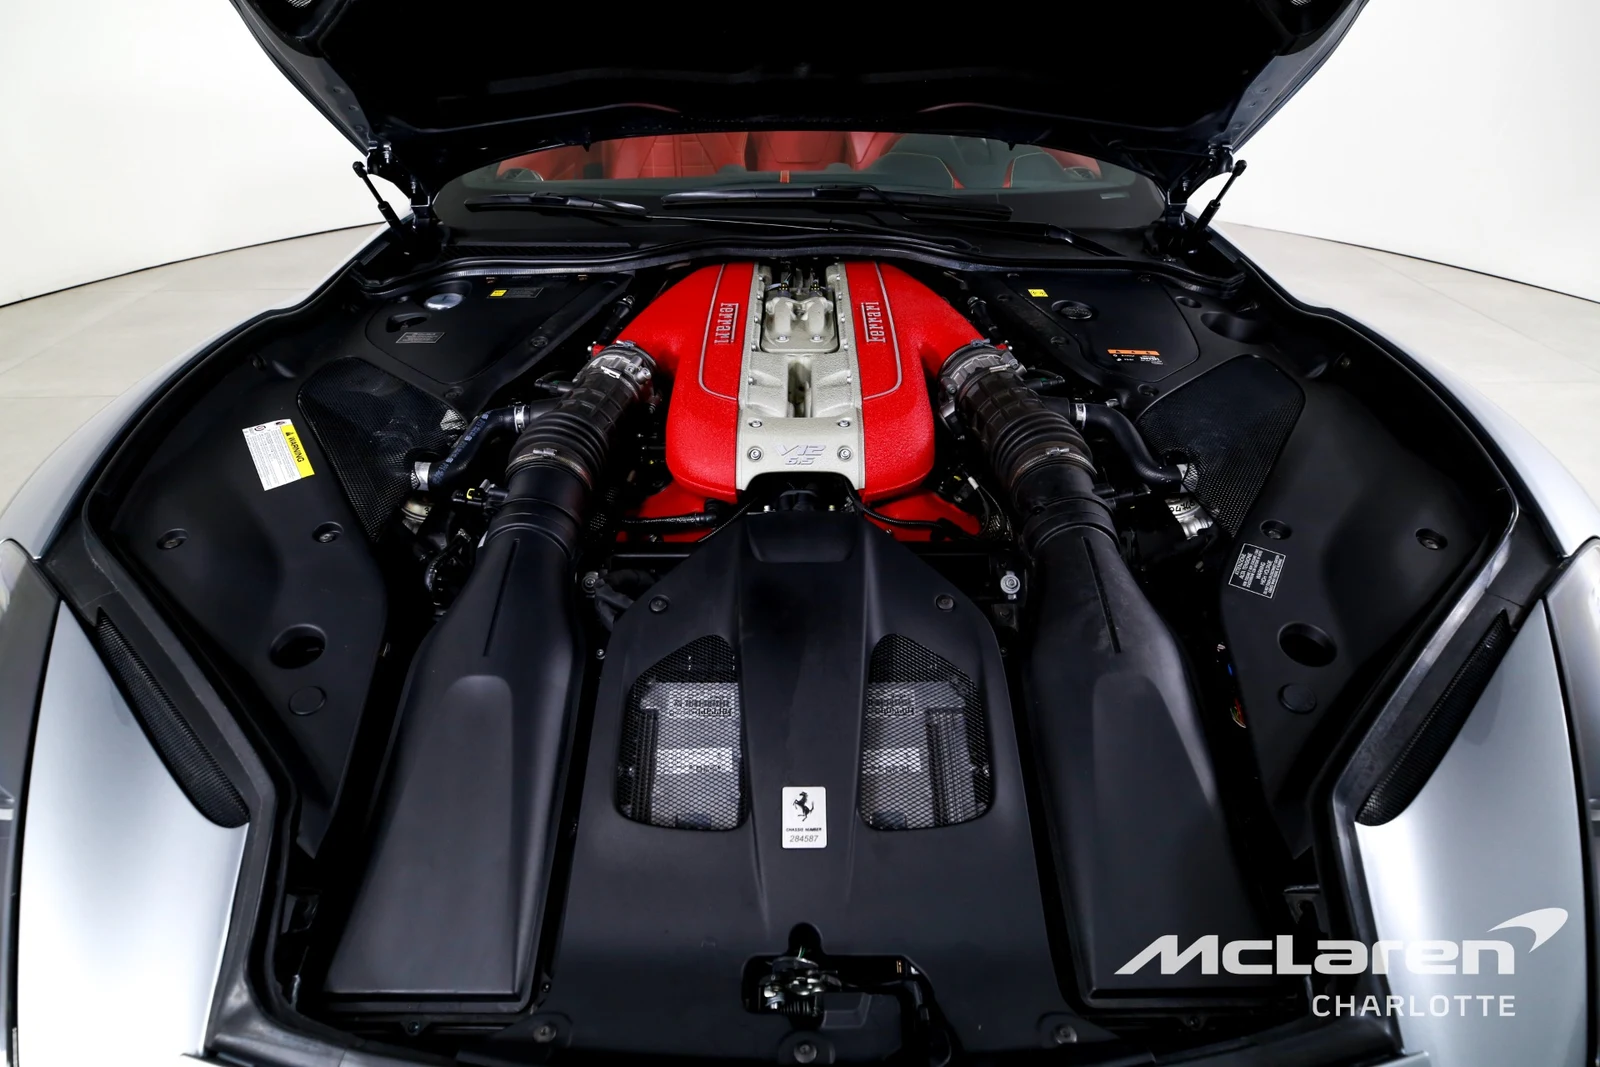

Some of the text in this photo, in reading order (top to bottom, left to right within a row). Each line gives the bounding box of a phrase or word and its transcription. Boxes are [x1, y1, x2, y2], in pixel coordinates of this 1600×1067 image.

[288, 436, 305, 463] WARNING
[775, 444, 827, 457] V12
[789, 834, 819, 843] 284587
